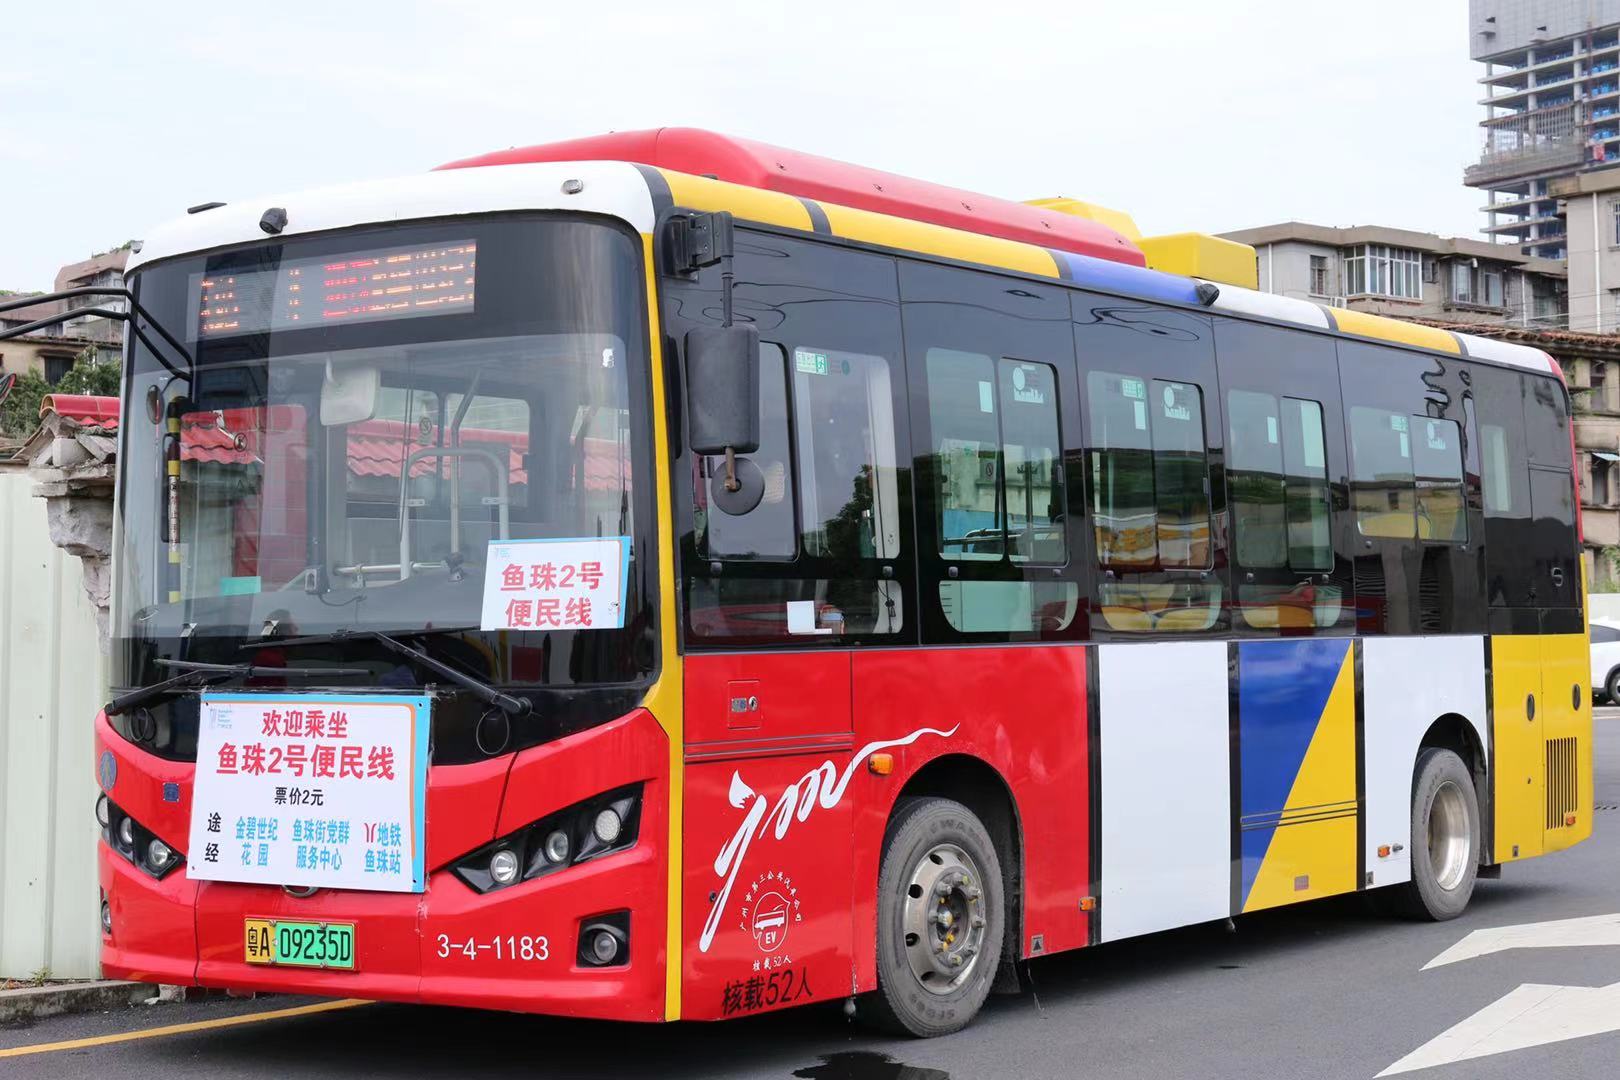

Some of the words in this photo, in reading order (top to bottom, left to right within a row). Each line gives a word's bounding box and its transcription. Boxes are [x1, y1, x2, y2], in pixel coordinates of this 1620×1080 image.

[500, 561, 604, 592] 鱼珠2号
[505, 597, 593, 628] 便民线
[261, 709, 348, 739] 欢迎乘坐
[216, 742, 396, 781] 鱼珠2号便民线
[274, 786, 324, 806] 票价2元
[235, 816, 279, 842] 金碧世纪
[291, 818, 351, 845] 鱼珠街党群
[377, 822, 402, 847] 地铁
[296, 845, 343, 870] 服务中心
[364, 849, 401, 875] 鱼珠站
[436, 933, 550, 961] 3-4-1183
[765, 930, 777, 945] EV
[722, 966, 813, 1016] 核载52人
